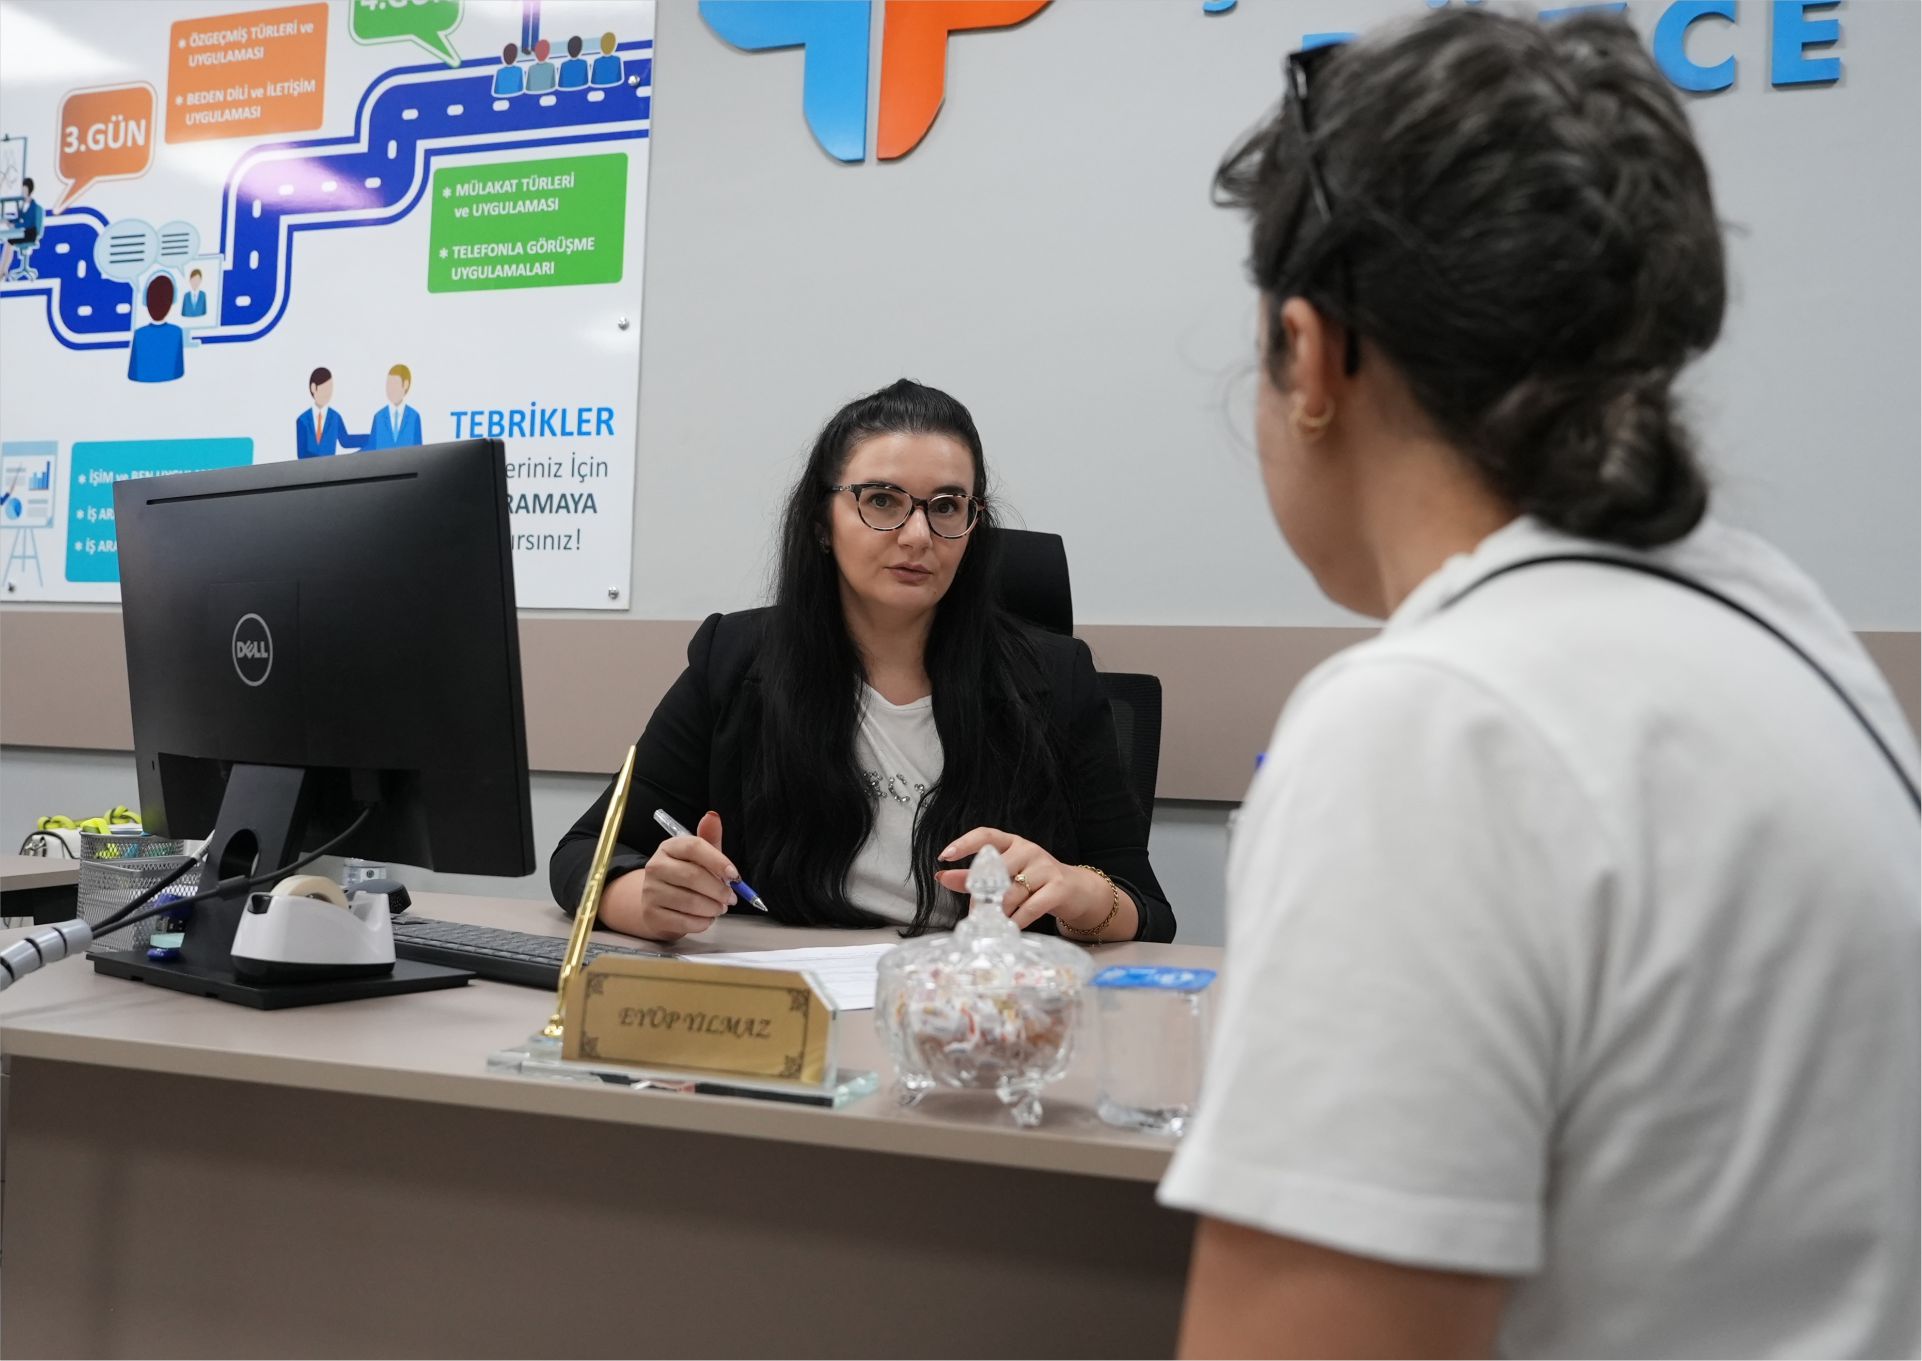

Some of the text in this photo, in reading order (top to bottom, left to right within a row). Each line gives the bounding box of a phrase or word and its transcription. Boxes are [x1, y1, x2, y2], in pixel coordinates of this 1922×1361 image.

[189, 19, 314, 48] ÖZGEÇMİŞ TÜRLERİ ve
[188, 47, 265, 67] UYGULAMASI
[186, 78, 316, 106] BEDEN DİLİ ve İLETİŞİM
[185, 106, 262, 125] UYGULAMASI
[63, 114, 147, 154] 3.GÜN
[455, 172, 575, 197] MÜLAKAT TÜRLERİ
[454, 197, 559, 218] ve UYGULAMASI
[452, 235, 596, 260] TELEFONLA GÖRÜŞME
[451, 261, 555, 281] UYGULAMALARI
[450, 401, 615, 439] TEBRİKLER
[89, 468, 114, 487] İŞİM
[505, 451, 609, 483] eriniz İçin
[87, 505, 98, 523] İŞ
[505, 492, 598, 515] RAMAYA
[85, 537, 96, 555] İŞ
[511, 527, 581, 551] ırsınız!
[236, 640, 269, 659] DELL
[683, 1012, 772, 1039] YILMAZ
